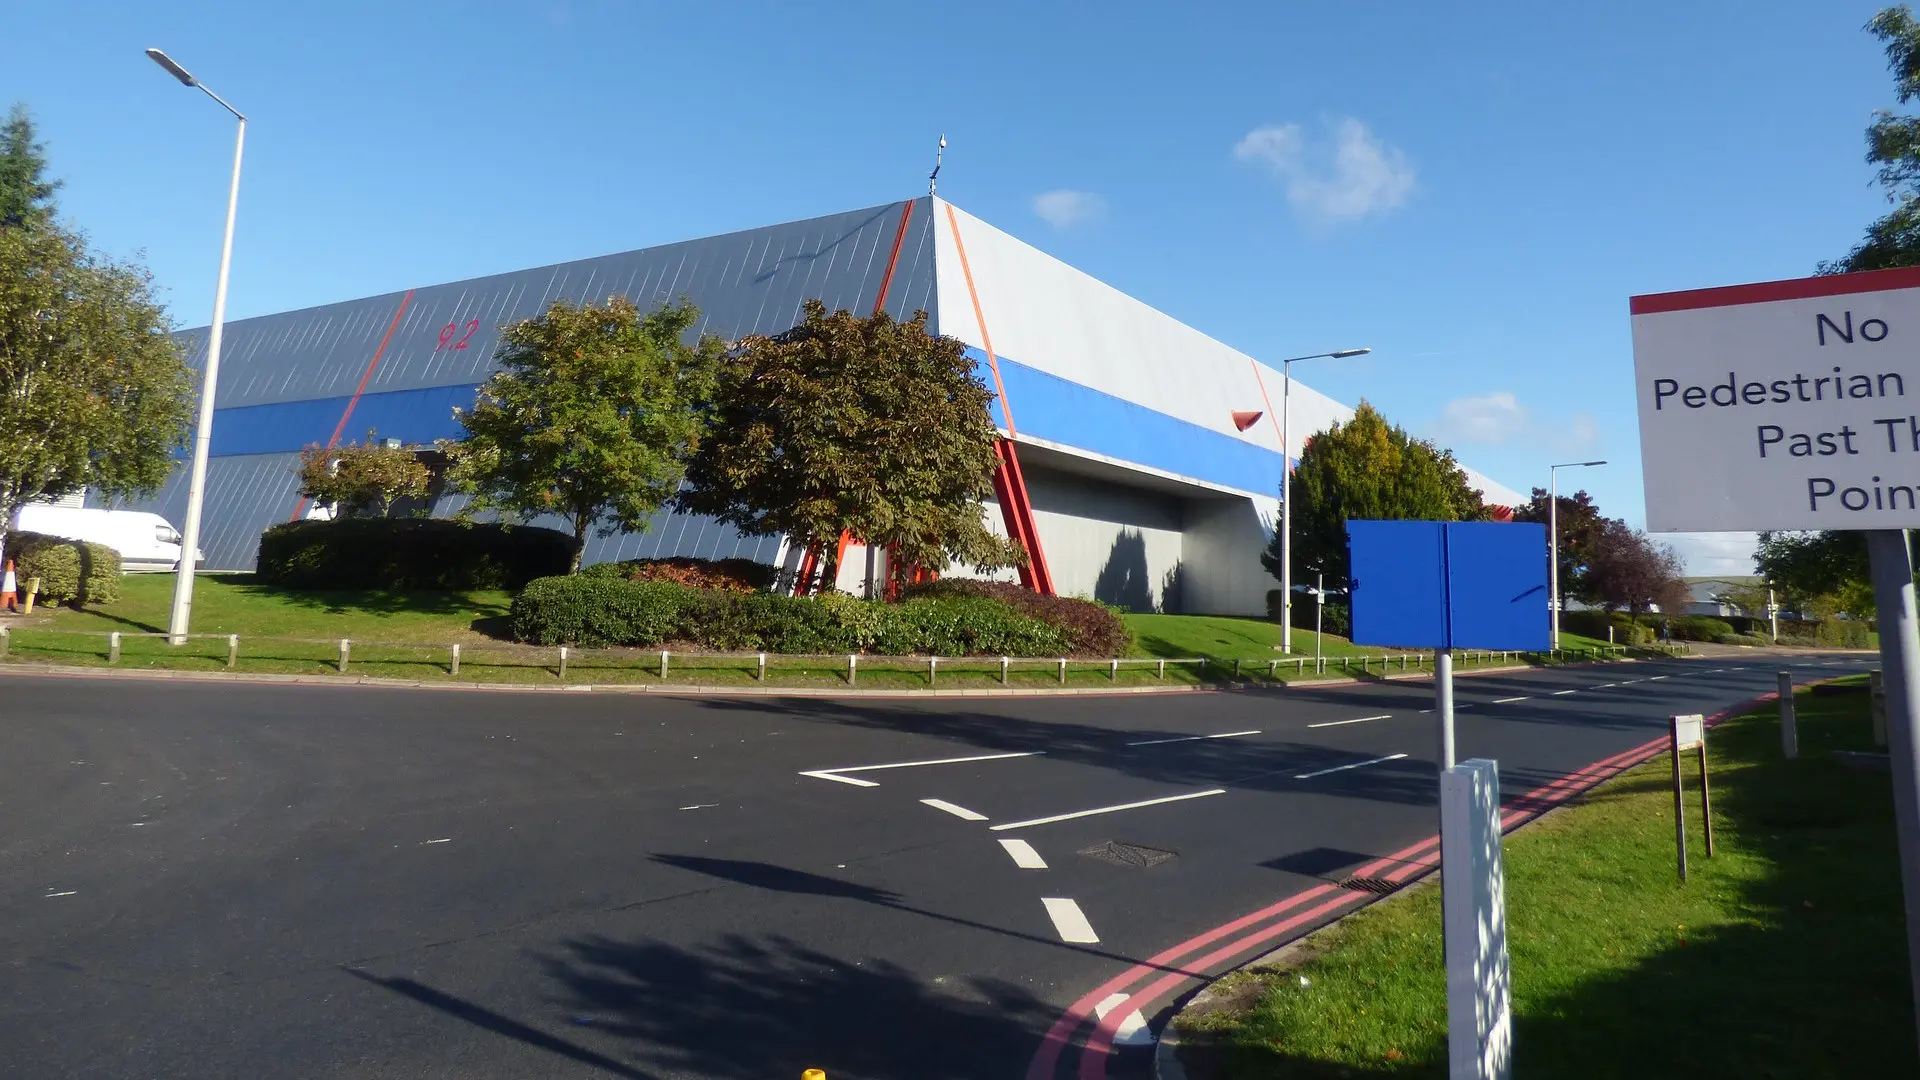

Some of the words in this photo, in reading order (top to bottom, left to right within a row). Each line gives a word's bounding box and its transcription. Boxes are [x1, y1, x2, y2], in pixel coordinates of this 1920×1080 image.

[434, 319, 479, 353] 9.2
[1816, 311, 1889, 346] No
[1654, 366, 1904, 410] Pedestrian
[1757, 425, 1859, 458] Past
[1808, 476, 1920, 512] Poin
